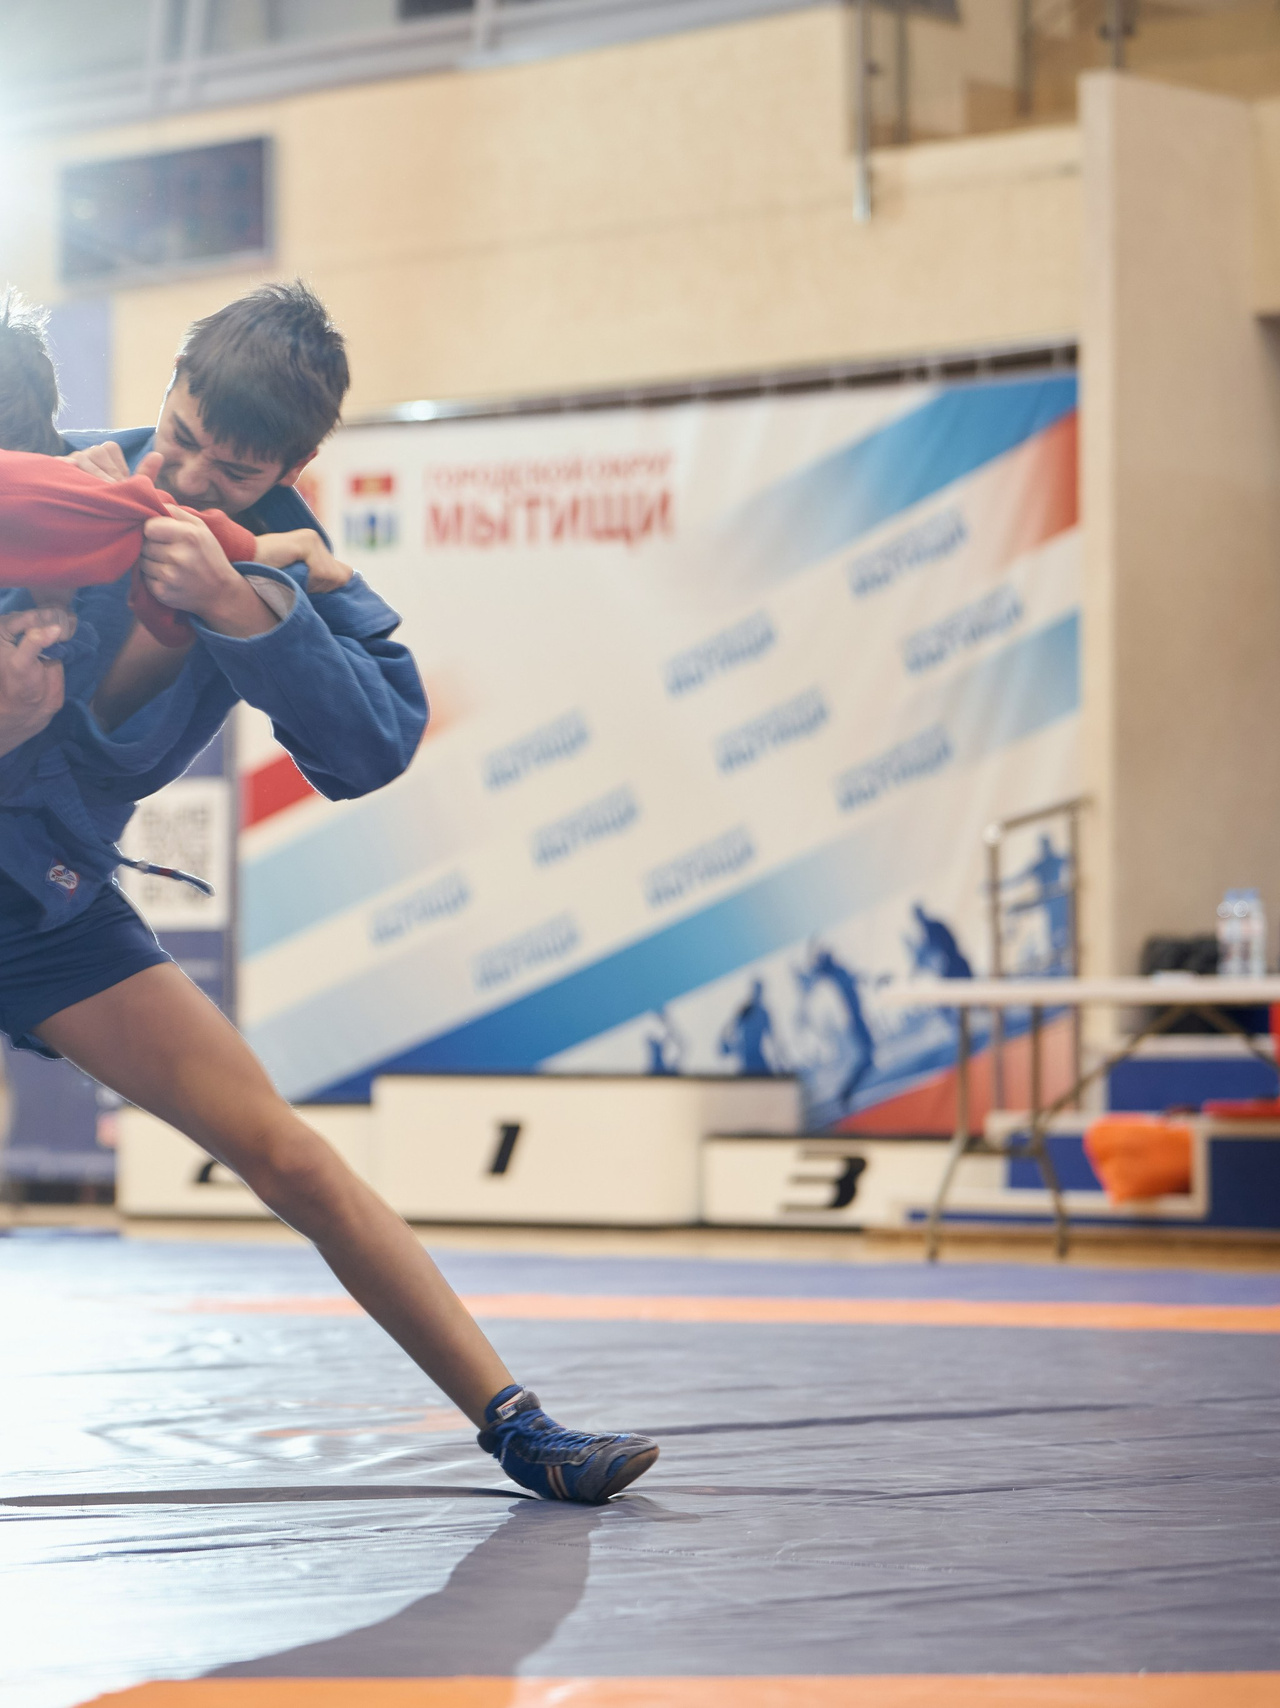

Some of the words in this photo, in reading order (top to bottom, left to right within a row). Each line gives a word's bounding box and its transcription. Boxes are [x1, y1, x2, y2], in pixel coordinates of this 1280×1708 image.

[423, 490, 672, 550] МЫТИЩИ
[483, 1119, 523, 1176] 1
[782, 1147, 868, 1212] 3
